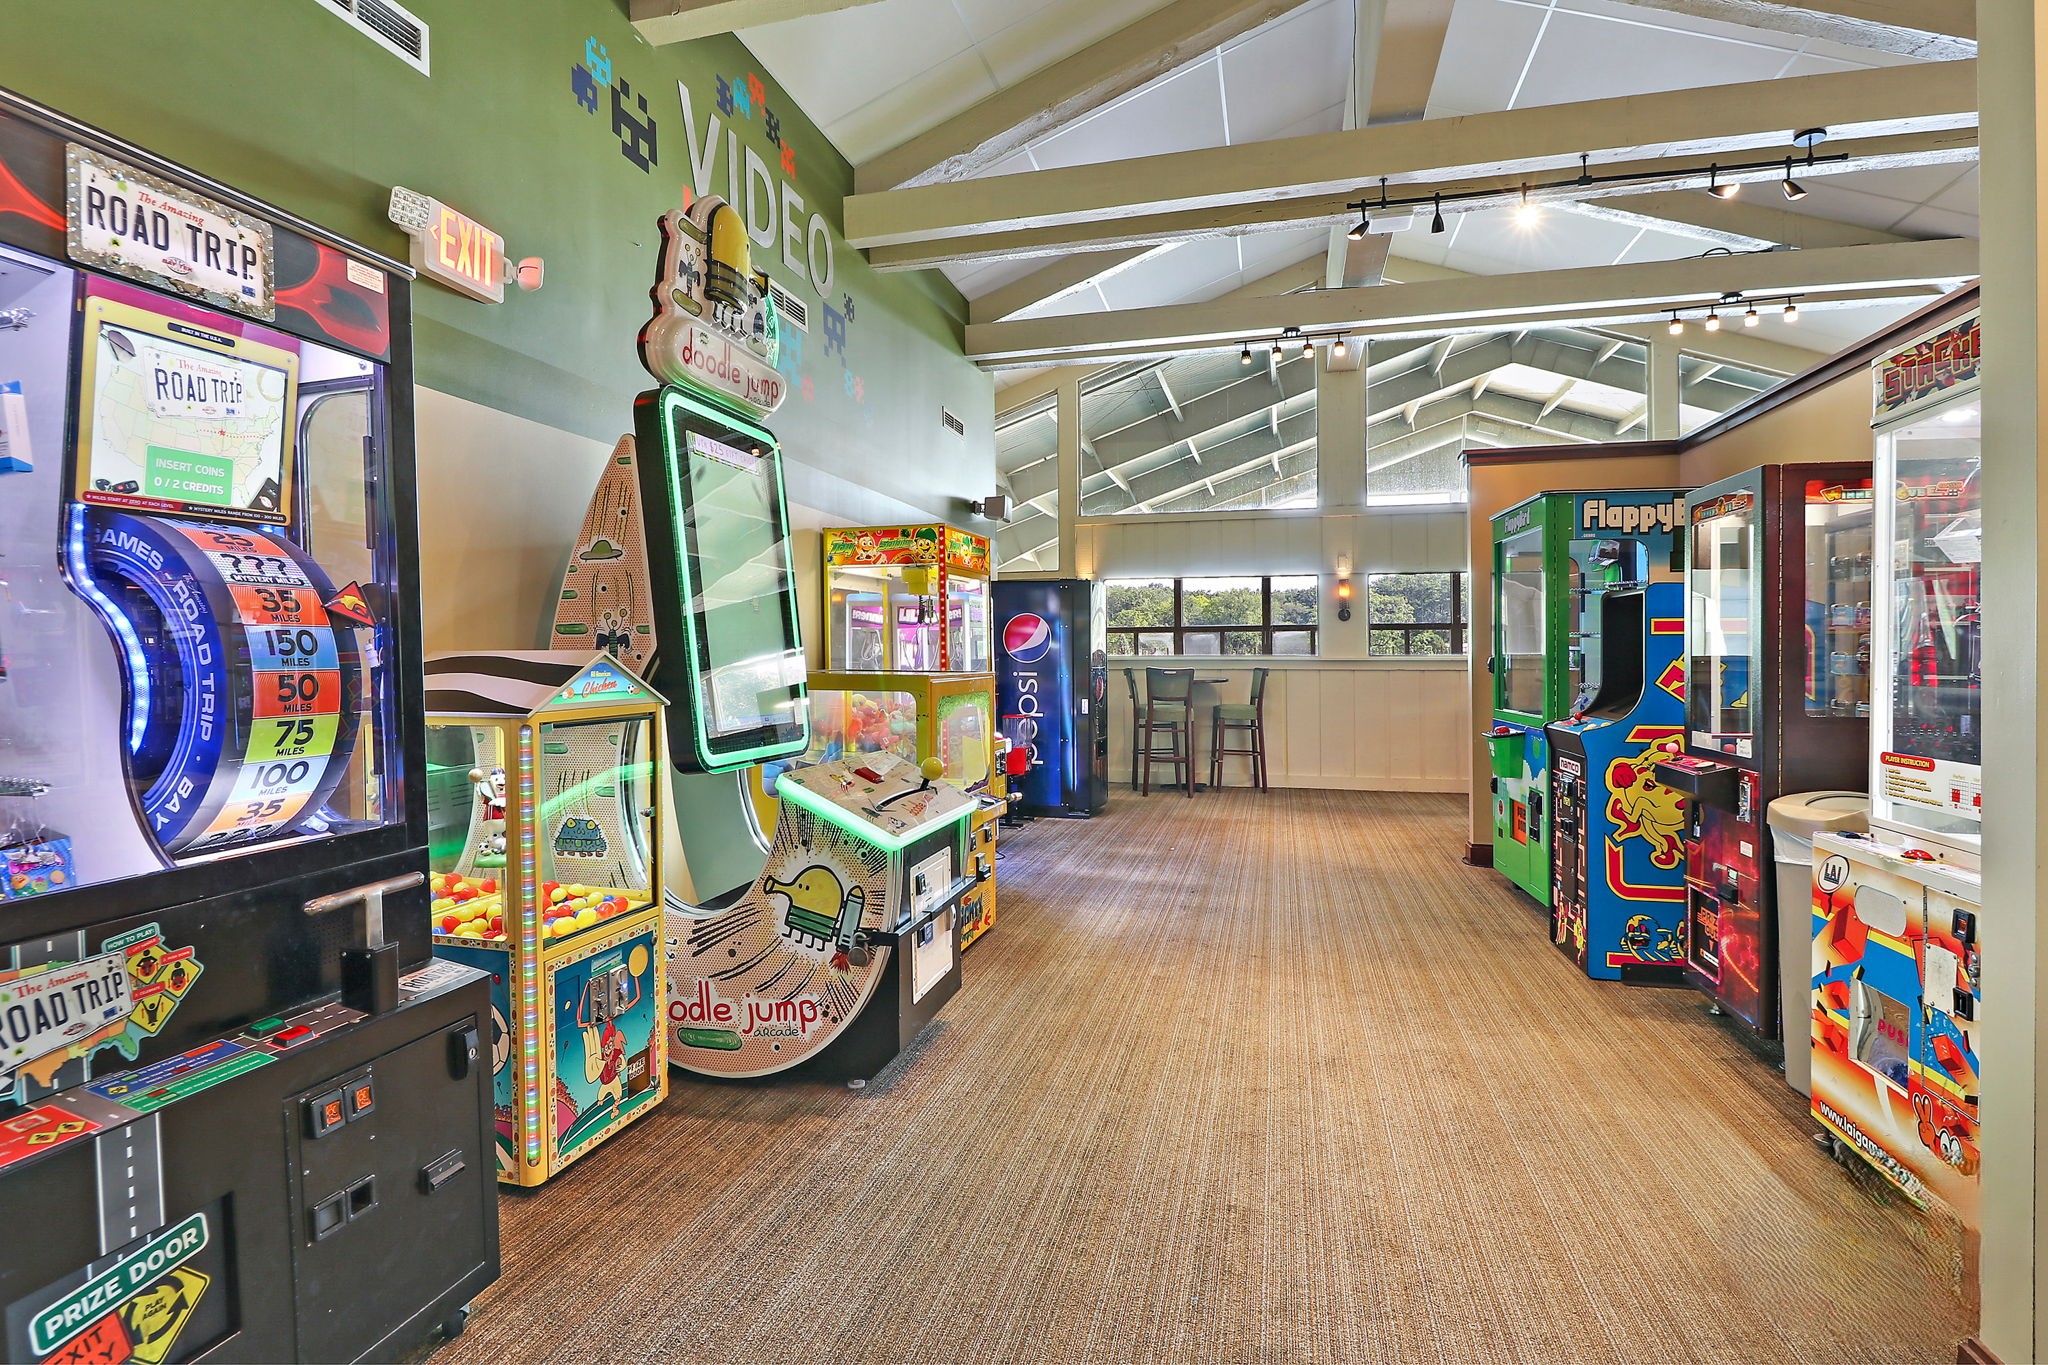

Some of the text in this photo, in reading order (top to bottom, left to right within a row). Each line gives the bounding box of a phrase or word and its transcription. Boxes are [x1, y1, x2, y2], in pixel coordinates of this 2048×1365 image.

[677, 80, 833, 298] VIDEO
[138, 191, 205, 228] The Amazing
[87, 185, 257, 281] ROAD TRIP
[440, 207, 495, 288] EXIT
[178, 359, 194, 371] The
[682, 327, 779, 407] doodle jump
[154, 368, 243, 404] ROAD TRIP
[155, 458, 225, 478] INSERT COINS
[172, 479, 180, 489] 2
[182, 481, 224, 495] CREDITS
[1821, 485, 1873, 502] WINNE
[193, 506, 213, 514] MYSTERY
[1583, 499, 1685, 533] FlappyB
[203, 531, 254, 547] 25
[233, 574, 301, 585] MYSTERY MILES
[255, 588, 301, 613] 35
[271, 614, 301, 623] MILES
[265, 629, 319, 657] 150
[172, 580, 215, 742] ROAD TRIP
[281, 656, 311, 667] MILES
[278, 673, 320, 703] 50
[283, 702, 313, 713] MILES
[274, 718, 315, 748] 75
[275, 747, 306, 757] MILES
[251, 760, 310, 789] 100
[258, 786, 288, 796] MILES
[155, 776, 195, 831] BAY
[237, 798, 286, 822] 35
[1701, 908, 1719, 928] PRIZ
[107, 940, 124, 950] HOW
[125, 935, 136, 943] TO
[13, 971, 90, 999] The Amazing
[72, 972, 123, 1014] TRIP
[669, 981, 818, 1034] odle jump
[753, 1021, 800, 1037] arcade
[44, 1227, 199, 1340] PRIZE DOOR
[142, 1303, 167, 1321] AGAIN
[144, 1296, 165, 1311] PLAY
